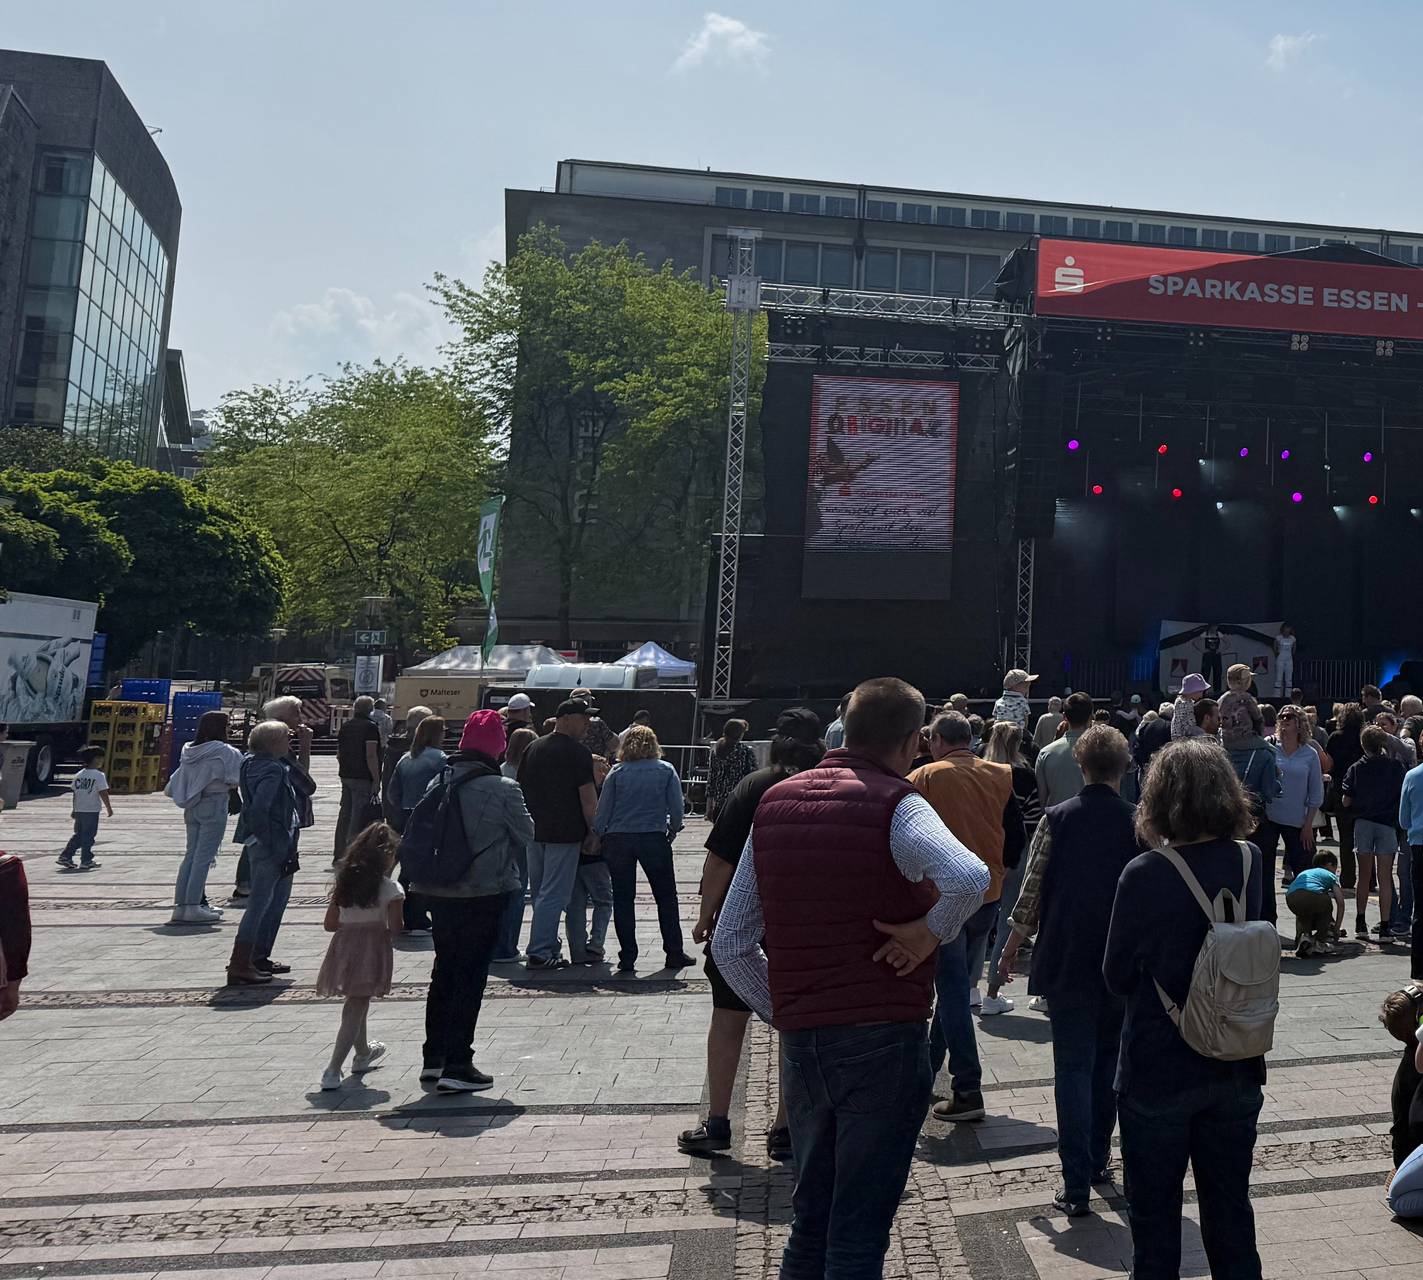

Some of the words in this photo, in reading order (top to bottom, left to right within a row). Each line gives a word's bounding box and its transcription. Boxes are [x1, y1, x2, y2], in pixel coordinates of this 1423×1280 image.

[1147, 274, 1314, 306] SPARKASSE
[1322, 287, 1409, 313] ESSEN
[835, 396, 938, 415] ESSEN
[430, 688, 461, 696] Malteser
